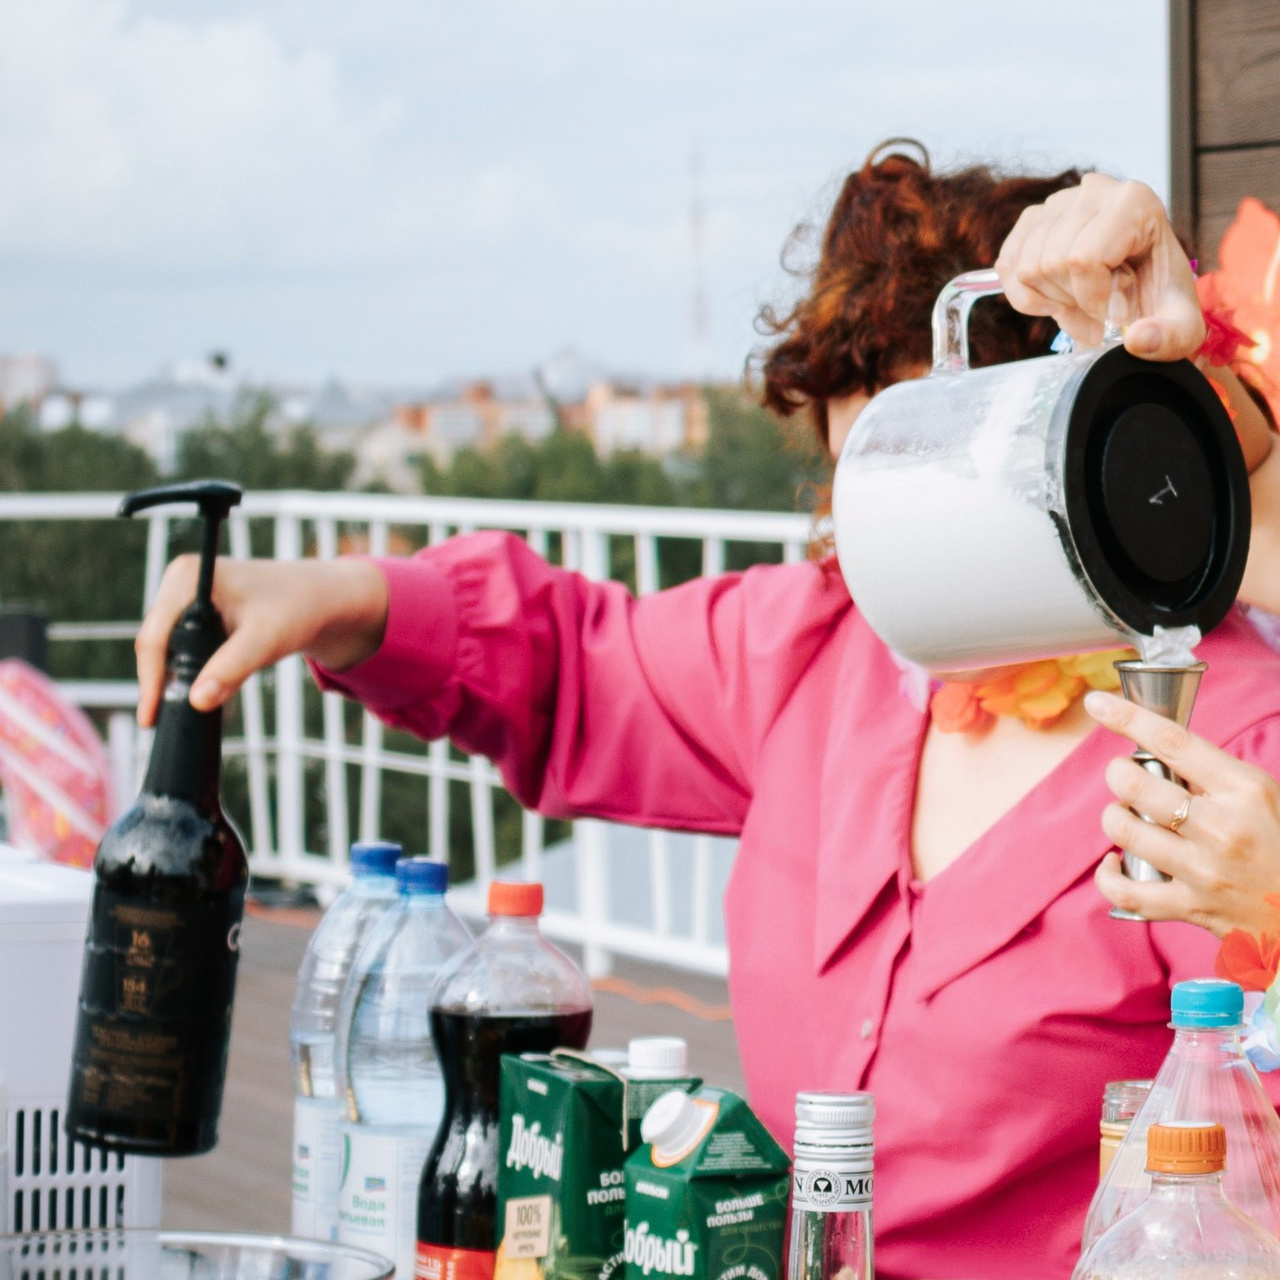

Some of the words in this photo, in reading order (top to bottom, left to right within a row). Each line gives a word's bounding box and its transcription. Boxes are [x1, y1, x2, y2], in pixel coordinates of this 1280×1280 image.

[352, 1195, 386, 1212] Вода
[515, 1203, 542, 1227] 100%
[715, 1192, 765, 1215] БОЛЬШЕ
[706, 1209, 755, 1228] ПОЛЬЗЫ
[624, 1218, 696, 1276] обрый
